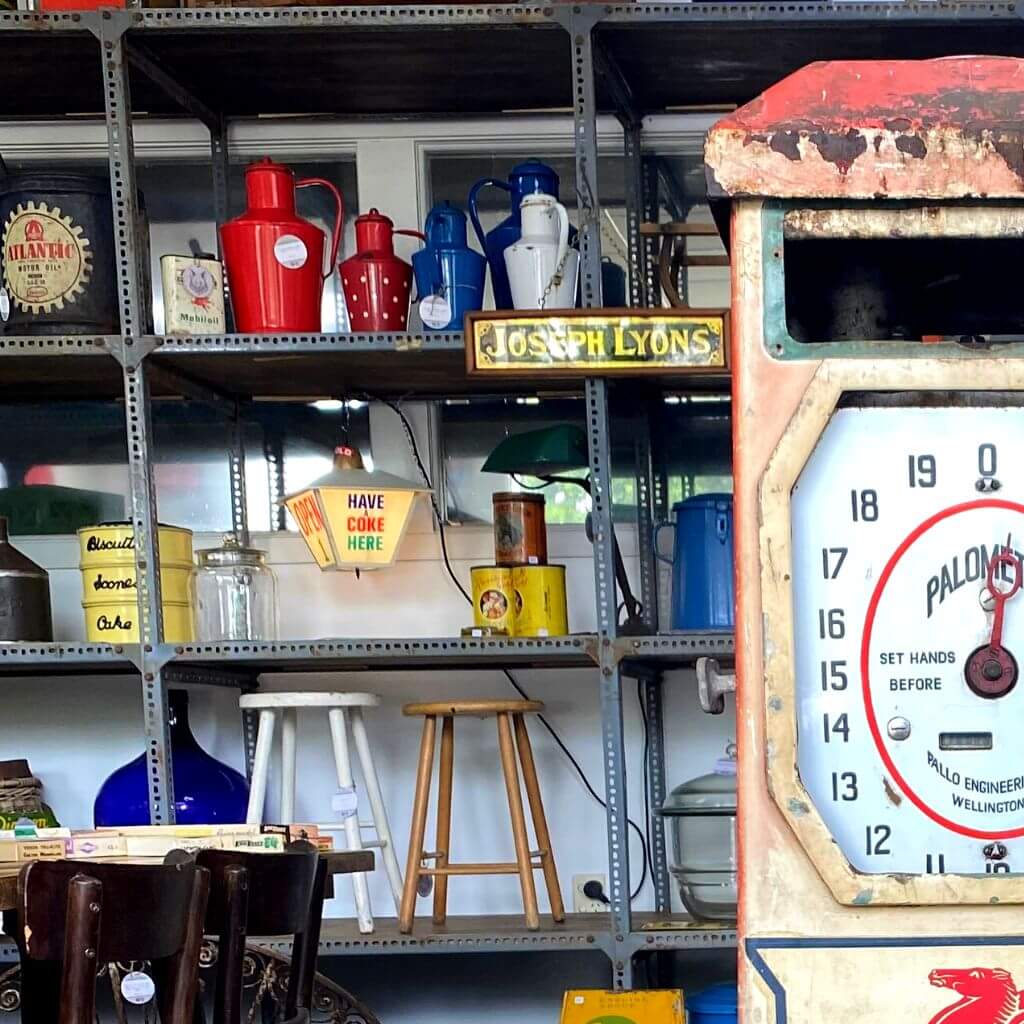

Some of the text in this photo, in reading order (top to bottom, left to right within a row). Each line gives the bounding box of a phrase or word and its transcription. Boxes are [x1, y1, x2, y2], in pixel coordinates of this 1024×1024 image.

[8, 243, 74, 261] ATLANTIC
[180, 313, 219, 325] Mobiloil
[614, 326, 711, 356] LYONS
[908, 454, 937, 489] 19
[978, 443, 997, 477] 0
[294, 494, 324, 537] OPEN
[348, 494, 384, 509] HAVE
[851, 489, 879, 522] 18
[347, 517, 384, 532] COKE
[87, 536, 136, 551] Biscuit
[348, 536, 383, 550] HERE
[822, 547, 848, 580] 17
[97, 615, 132, 631] Cake
[819, 608, 845, 639] 16
[879, 652, 904, 665] SET
[910, 651, 956, 664] HANDS
[821, 660, 848, 692] 15
[889, 677, 942, 691] BEFORE
[823, 713, 850, 744] 14
[927, 750, 960, 786] PALLO
[832, 772, 858, 802] 13
[952, 793, 1024, 813] WELLINGTON
[866, 824, 892, 856] 12
